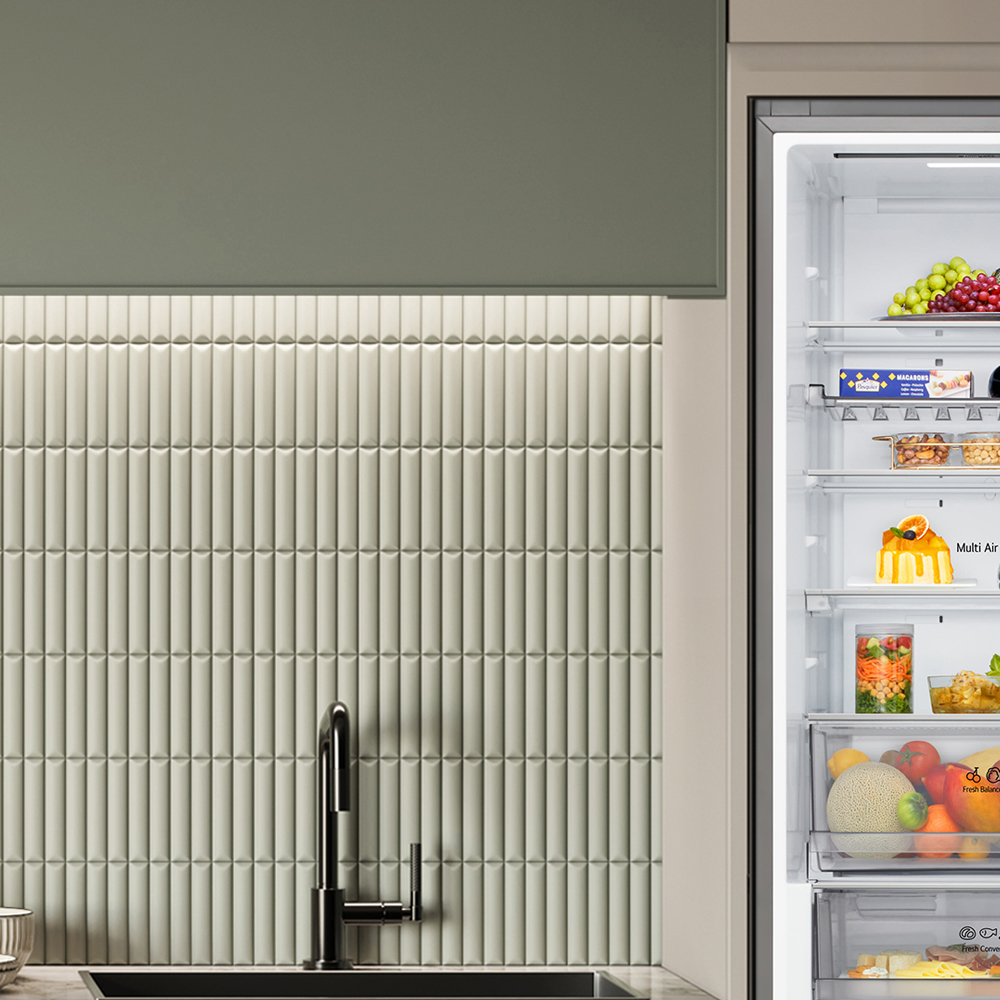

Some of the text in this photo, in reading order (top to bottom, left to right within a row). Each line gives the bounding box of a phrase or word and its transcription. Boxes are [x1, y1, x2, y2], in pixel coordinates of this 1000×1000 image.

[956, 542, 982, 553] Multi
[983, 542, 999, 553] Air
[962, 785, 980, 793] Fresh
